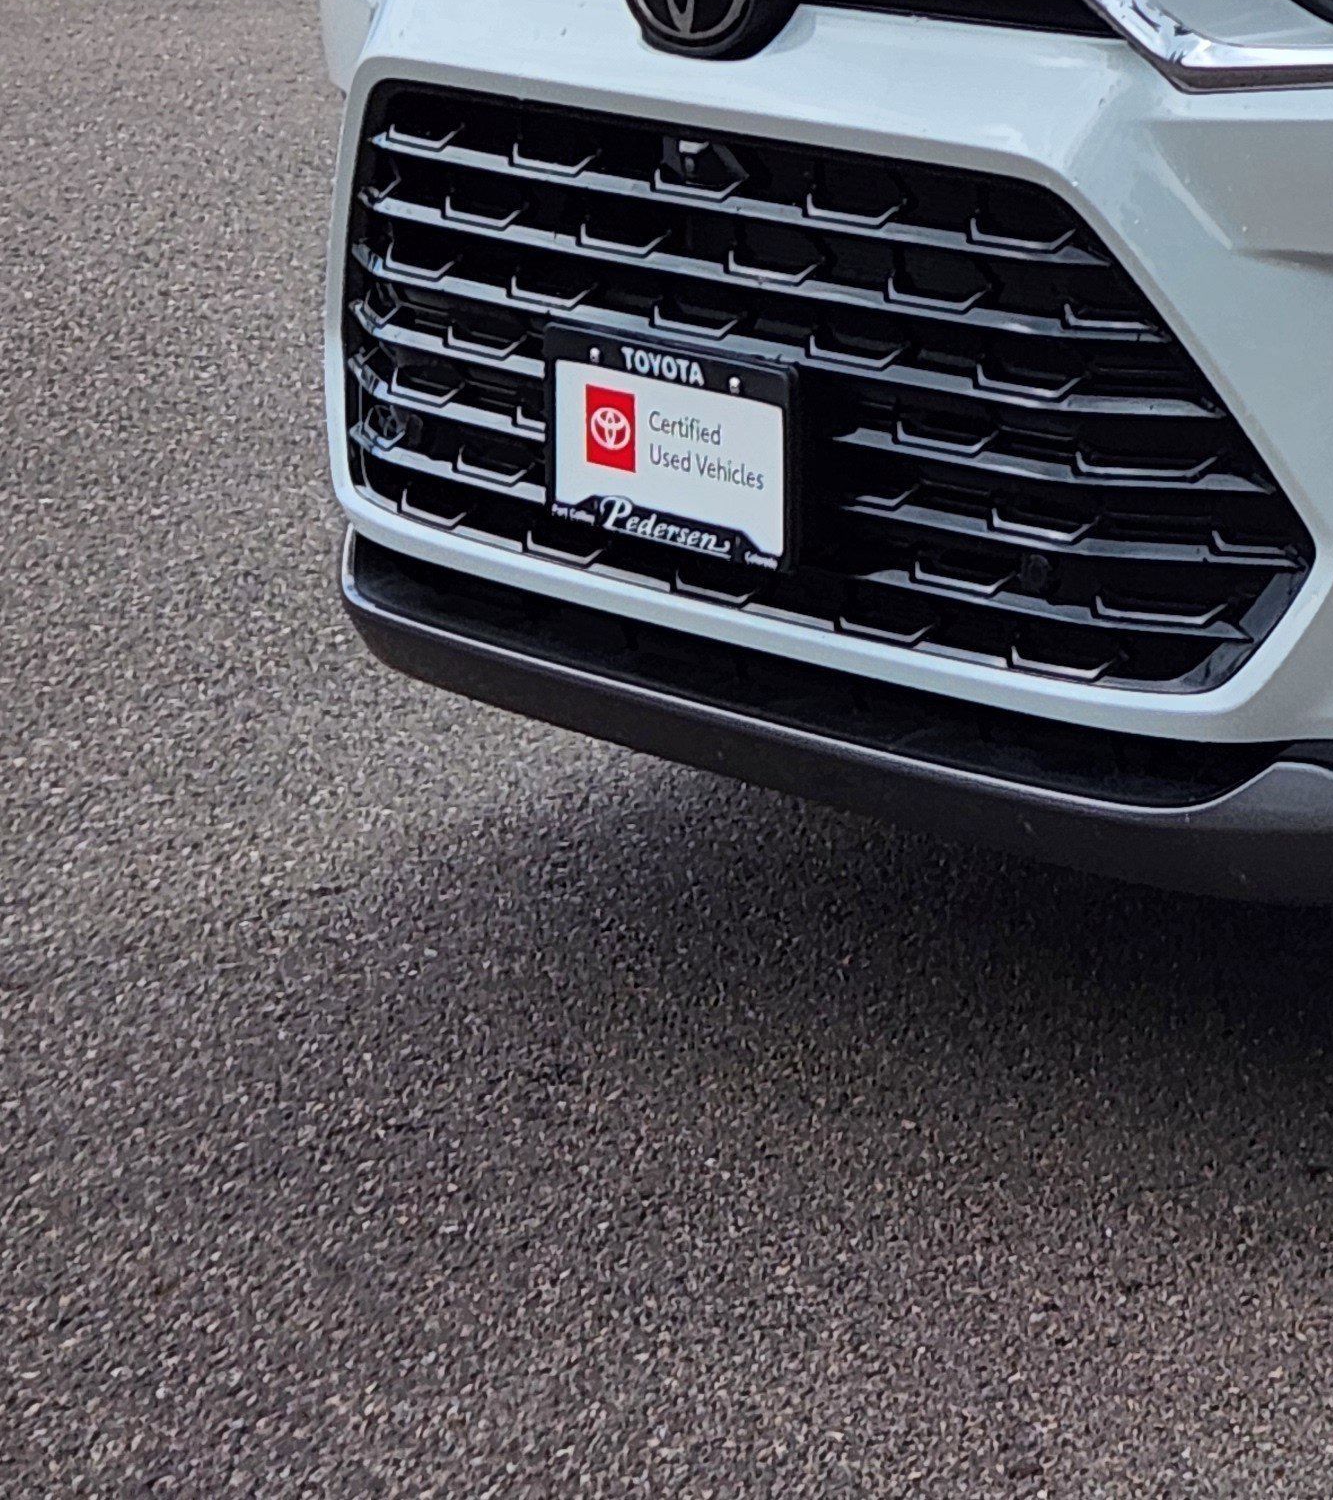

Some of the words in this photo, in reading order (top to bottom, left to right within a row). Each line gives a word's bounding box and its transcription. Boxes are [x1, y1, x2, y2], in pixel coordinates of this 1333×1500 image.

[620, 346, 706, 386] TOYOTA
[648, 410, 722, 446] Certified
[649, 442, 692, 473] Used
[695, 452, 765, 491] Vehicles
[599, 496, 731, 554] Pedersen
